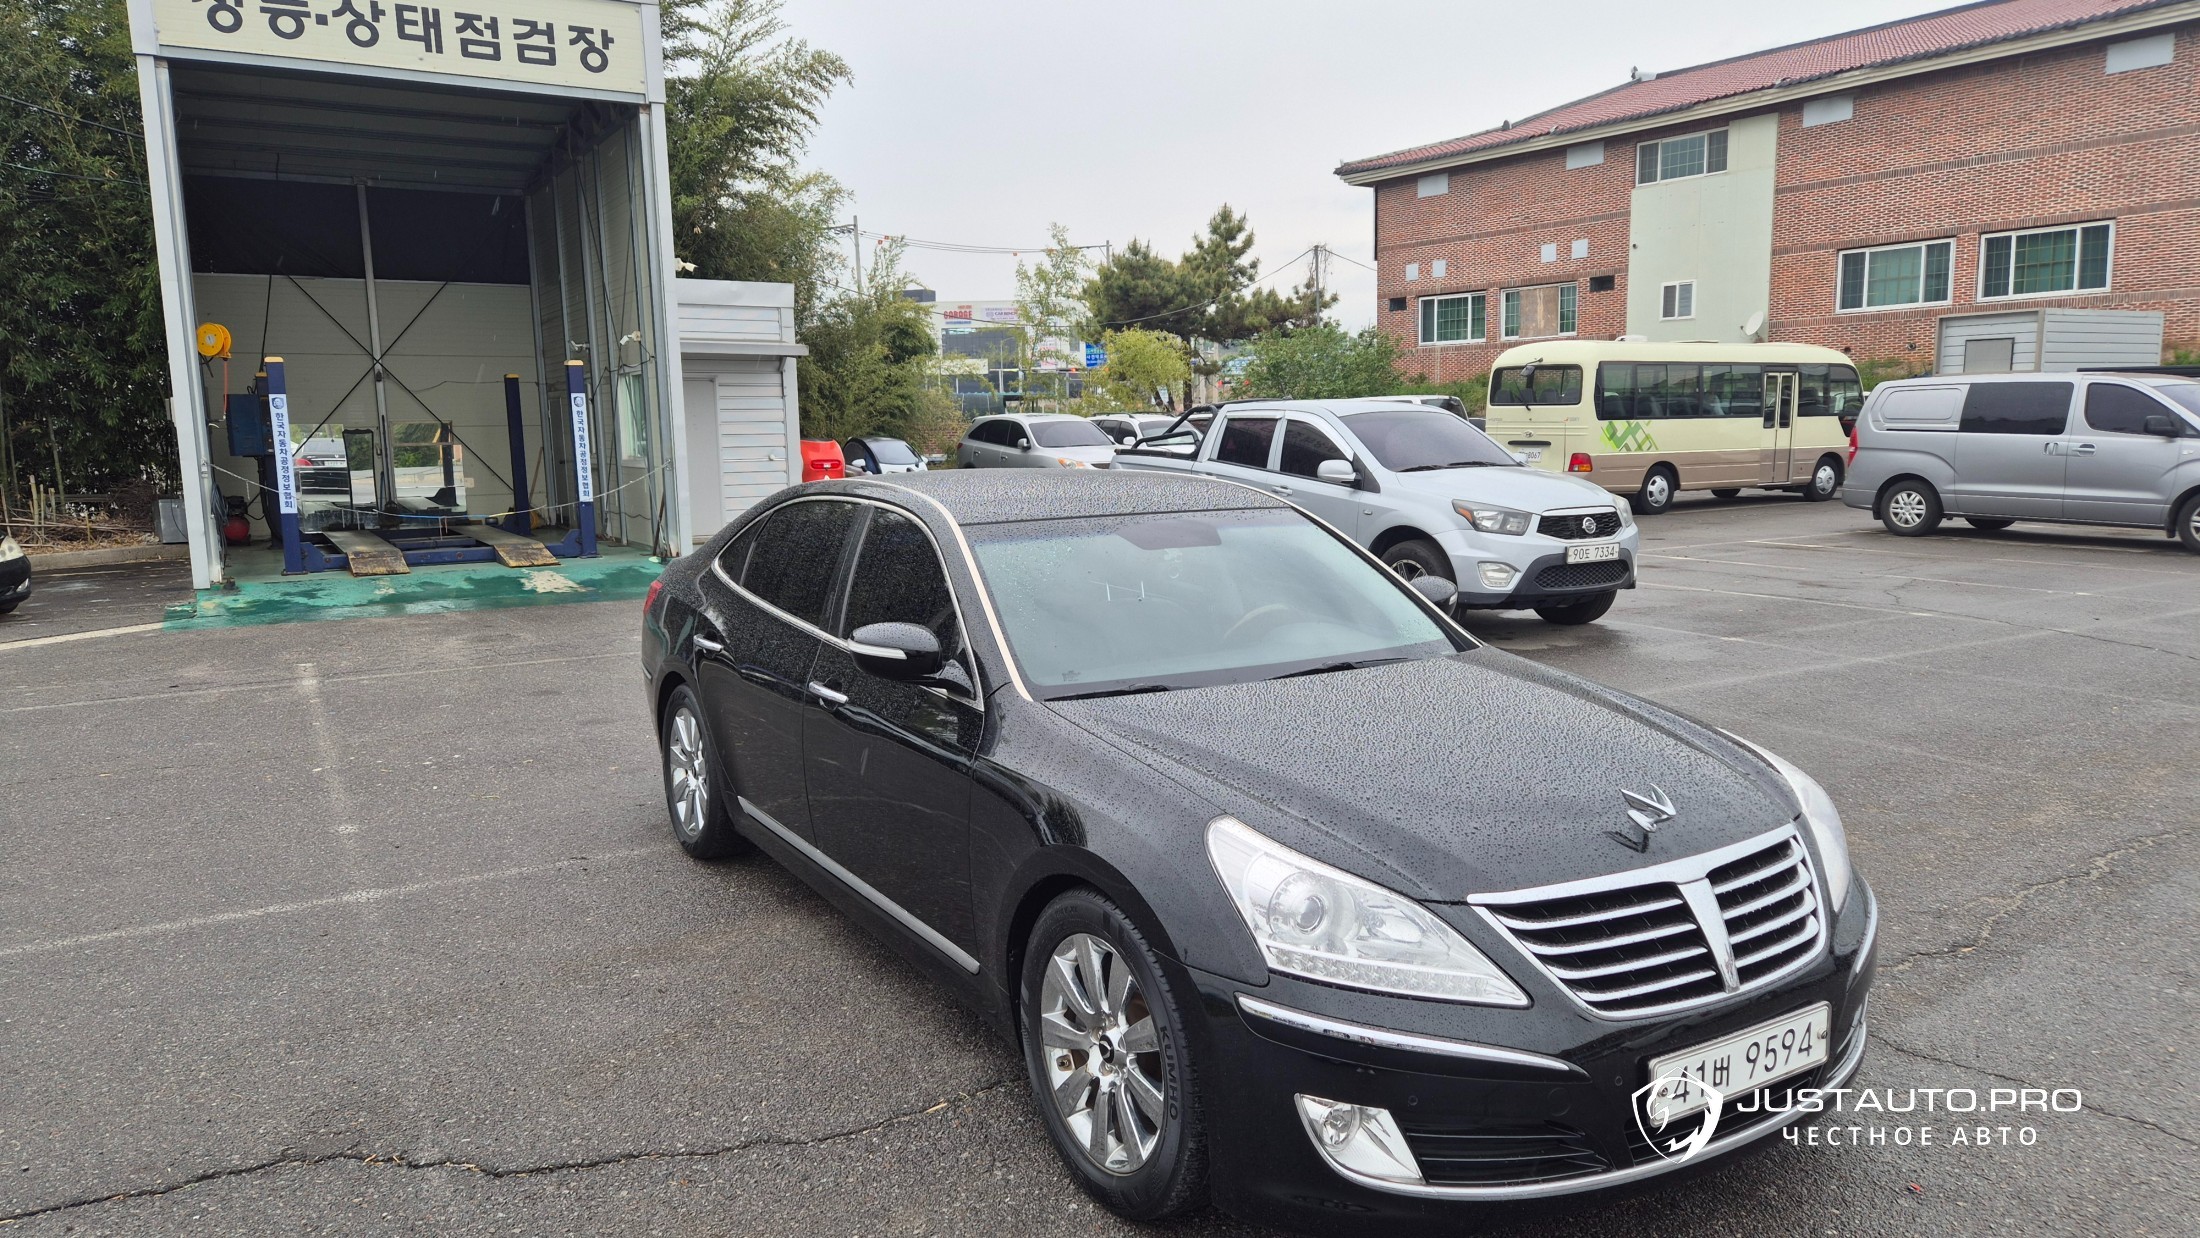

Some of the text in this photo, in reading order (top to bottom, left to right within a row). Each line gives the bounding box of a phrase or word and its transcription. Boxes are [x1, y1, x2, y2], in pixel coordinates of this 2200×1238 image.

[1595, 546, 1615, 559] 7334
[1160, 1026, 1178, 1120] KUMHO
[1672, 1022, 1813, 1103] 41버 9594
